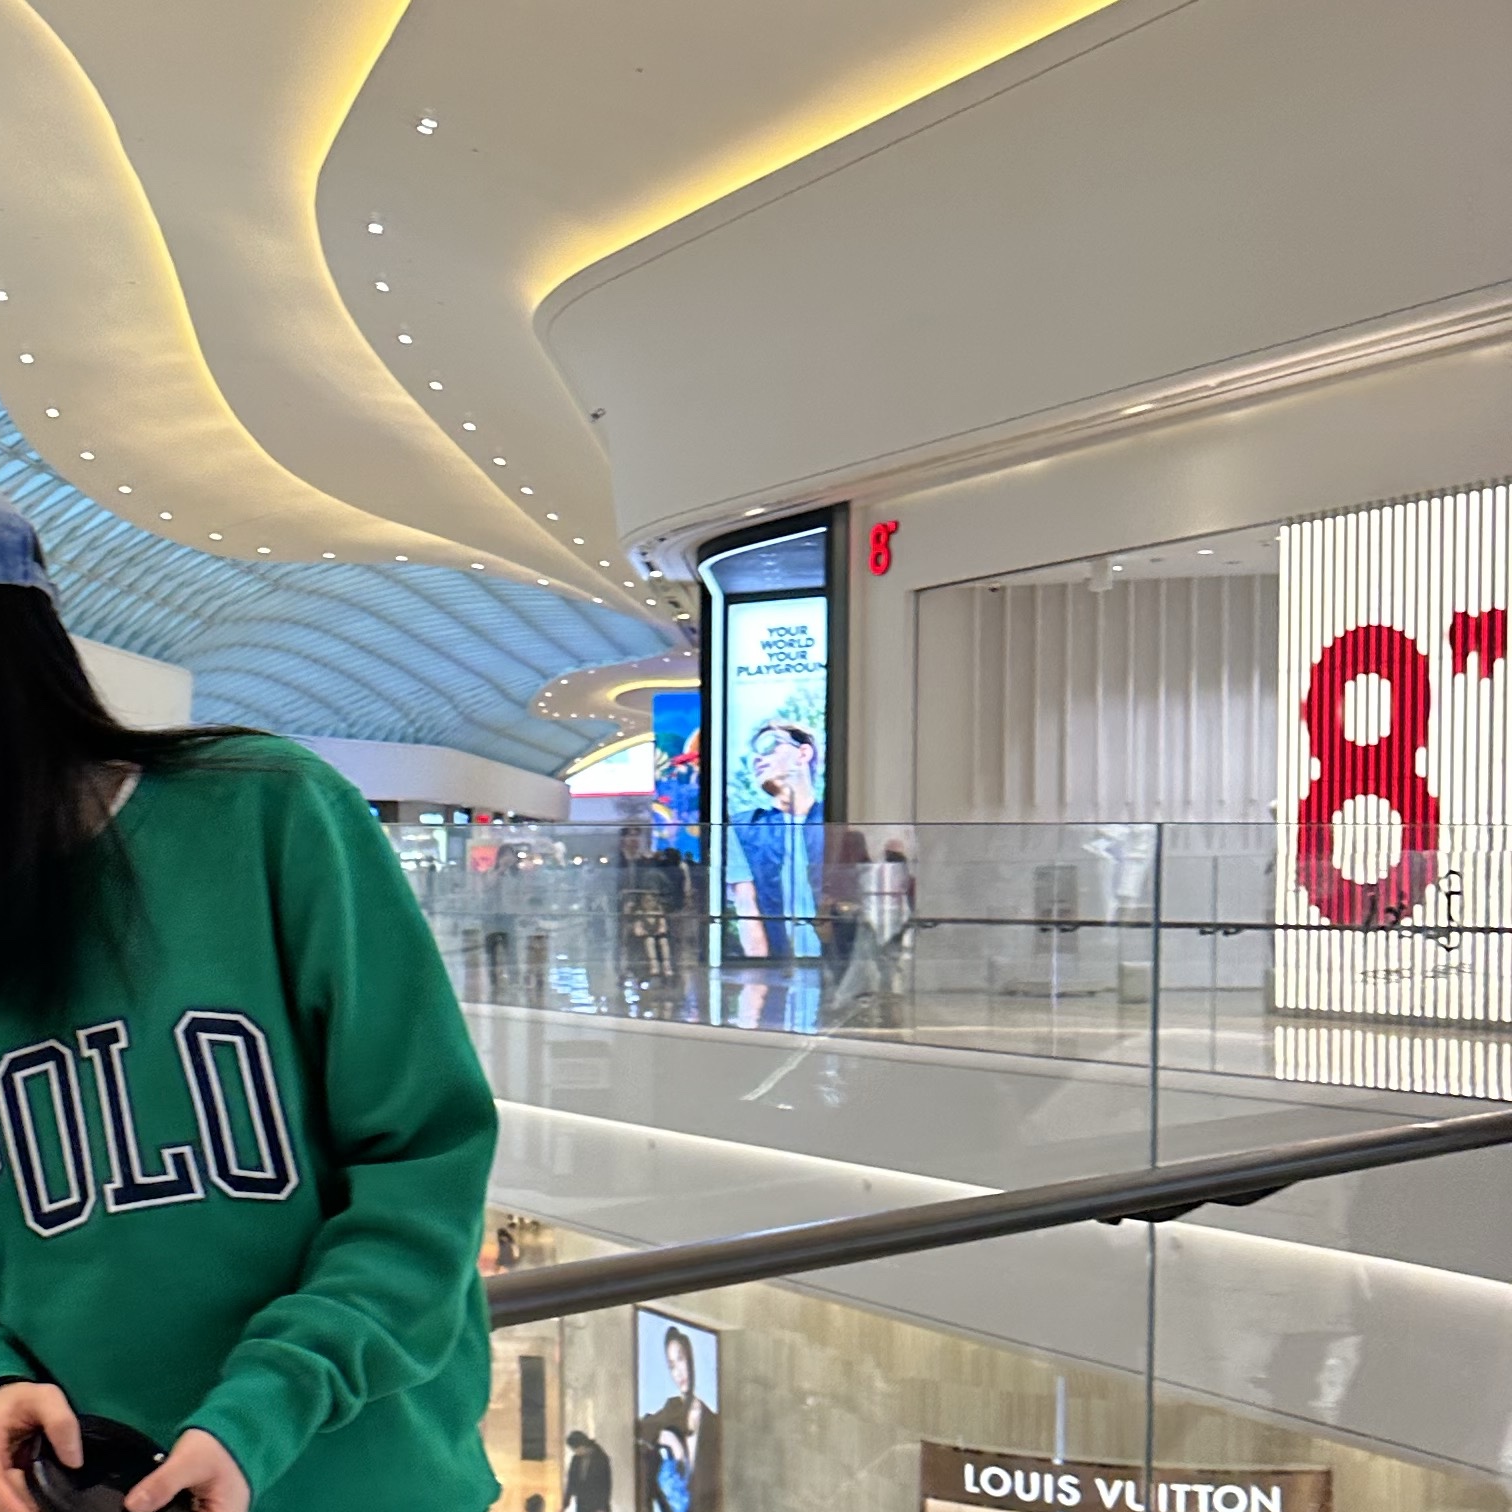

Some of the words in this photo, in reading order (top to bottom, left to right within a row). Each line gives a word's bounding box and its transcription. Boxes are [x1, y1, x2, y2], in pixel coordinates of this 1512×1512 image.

[766, 625, 809, 638] YOUR
[759, 637, 816, 650] WORLD
[766, 650, 809, 663] YOUR
[963, 1462, 1081, 1507] LOUIS
